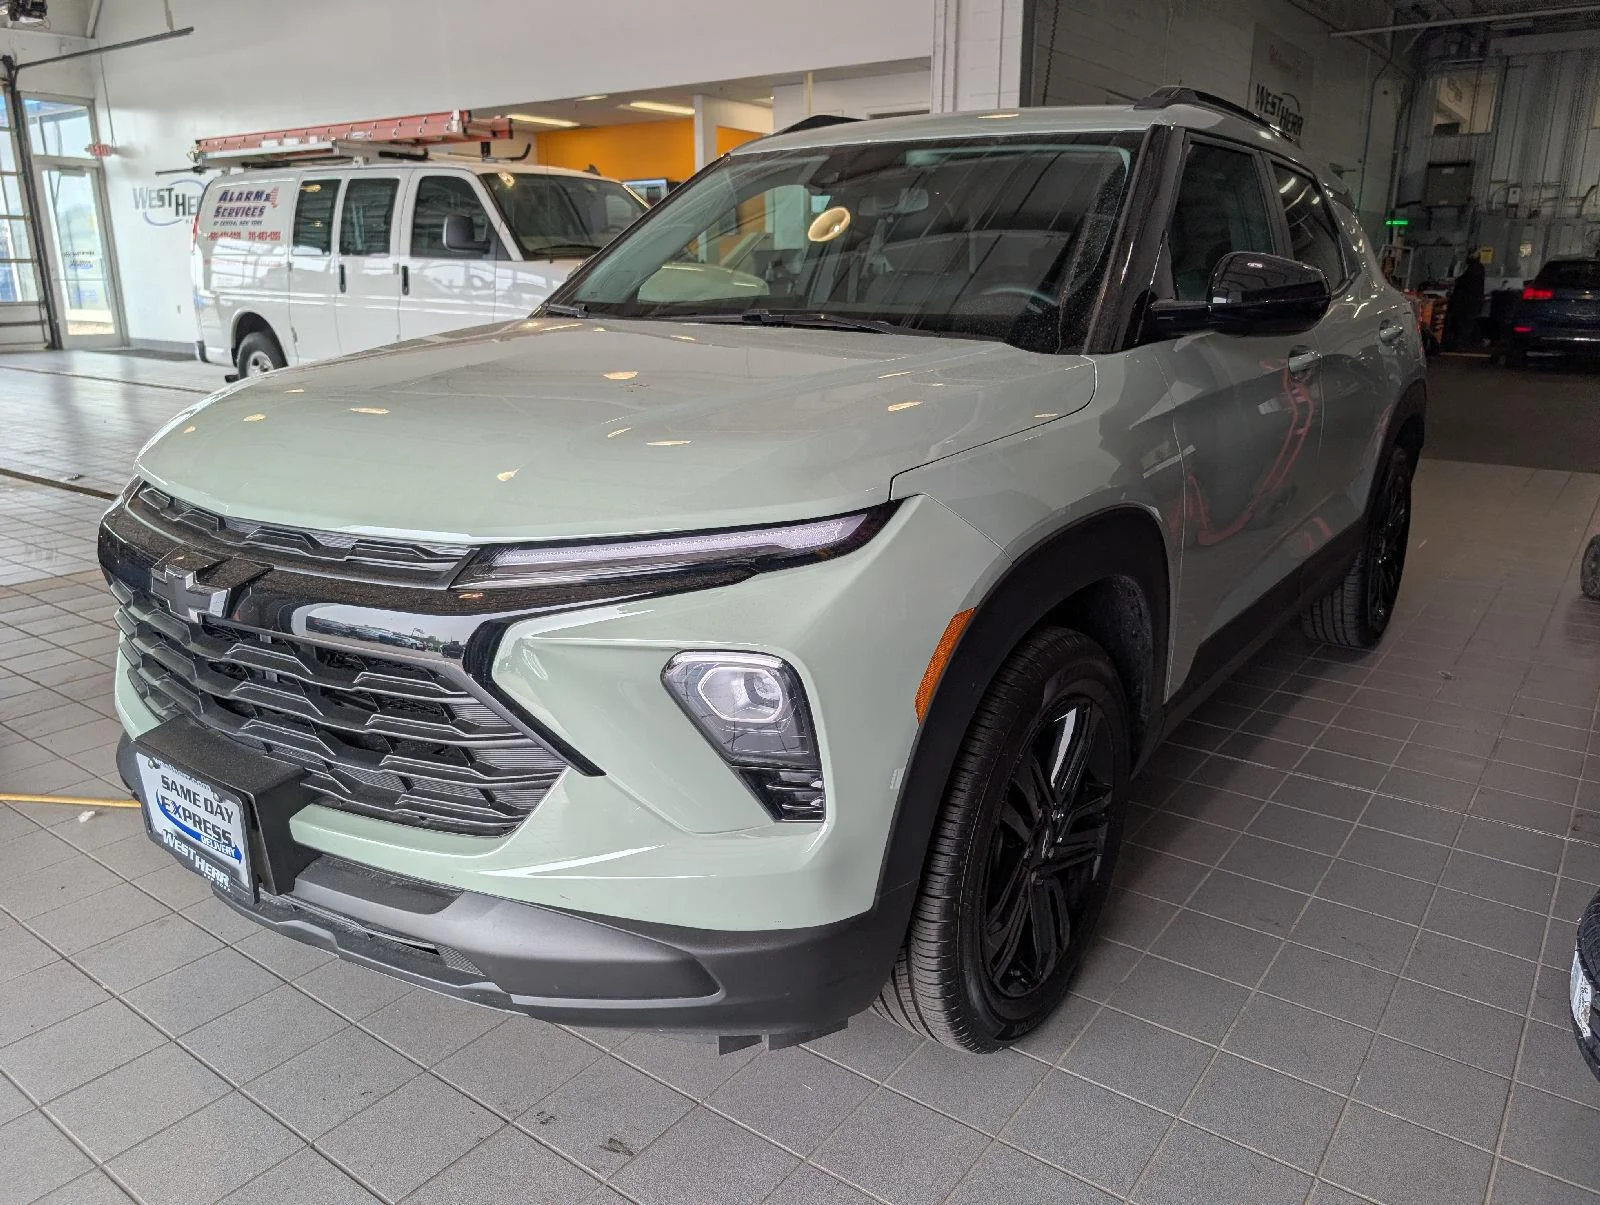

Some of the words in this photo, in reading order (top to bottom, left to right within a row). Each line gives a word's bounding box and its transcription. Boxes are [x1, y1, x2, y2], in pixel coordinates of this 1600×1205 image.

[1256, 83, 1283, 117] WEST
[1280, 105, 1304, 137] HERR
[132, 187, 174, 210] WEST
[175, 193, 202, 216] HE
[213, 205, 266, 218] SERVICES
[160, 795, 233, 846] EXPRESS
[161, 774, 202, 809] SAME
[203, 797, 234, 824] DAY
[162, 828, 197, 861] WEST
[194, 856, 231, 888] HERR
[201, 834, 236, 858] DELIVERY
